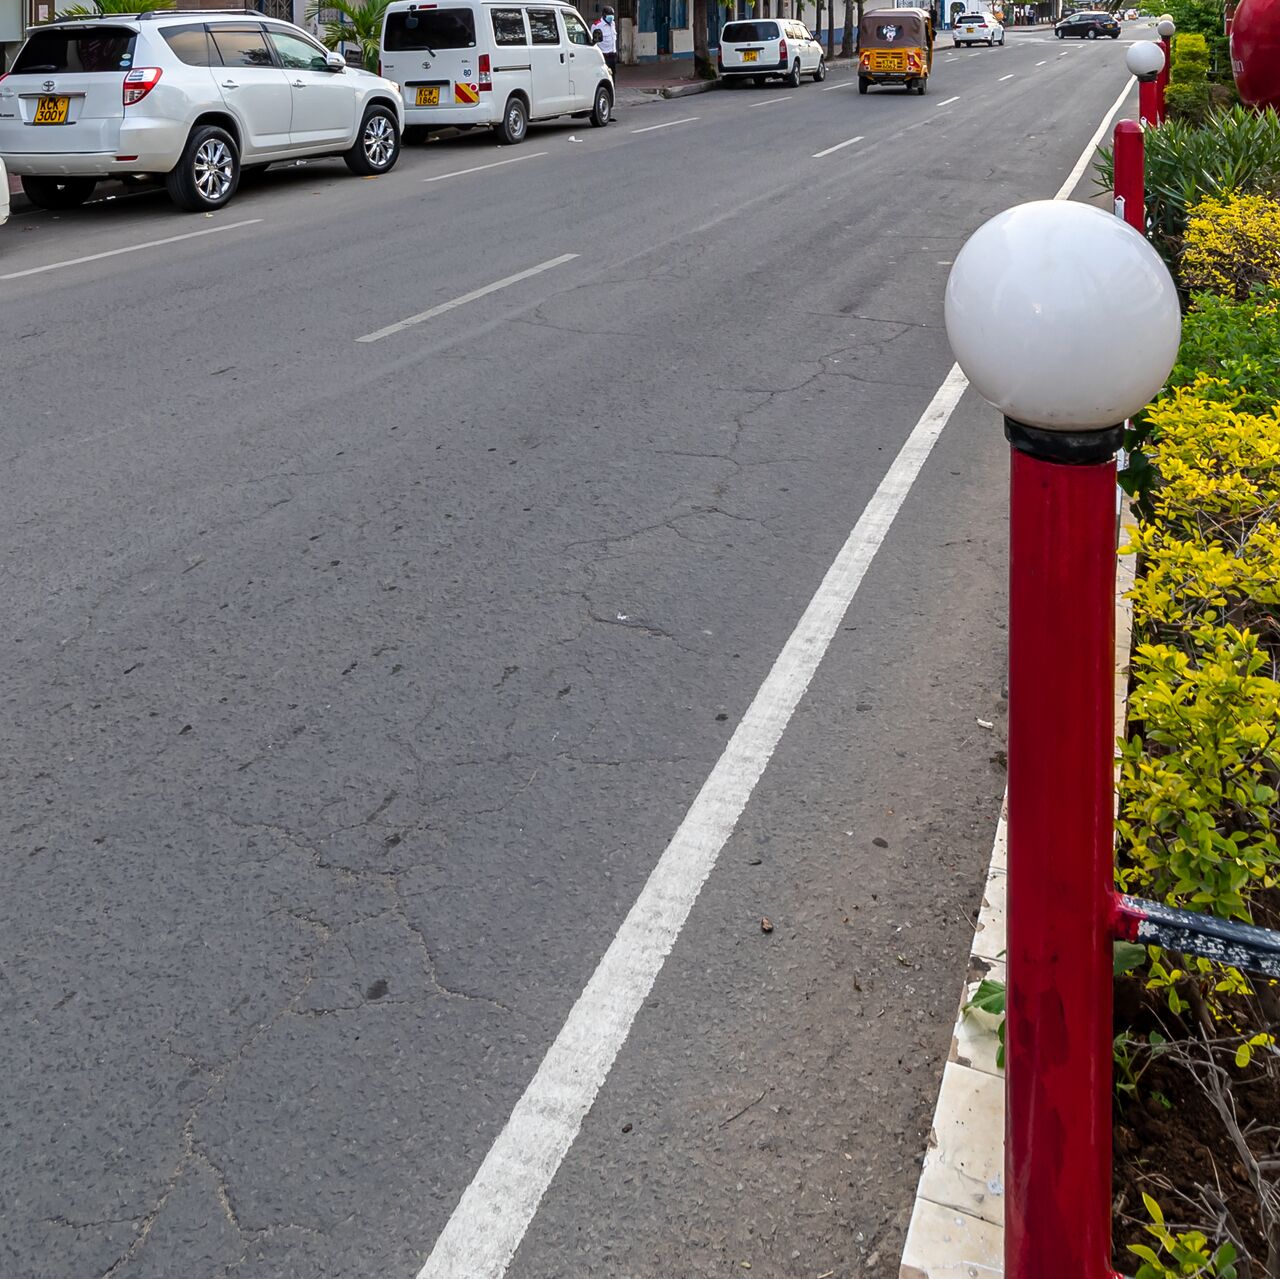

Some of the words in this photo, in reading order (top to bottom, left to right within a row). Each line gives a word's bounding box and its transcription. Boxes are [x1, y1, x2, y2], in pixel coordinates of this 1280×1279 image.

[463, 69, 472, 78] 80
[419, 89, 434, 97] KCW
[40, 97, 60, 111] KCK
[419, 96, 437, 105] 186C
[37, 110, 64, 122] 300Y
